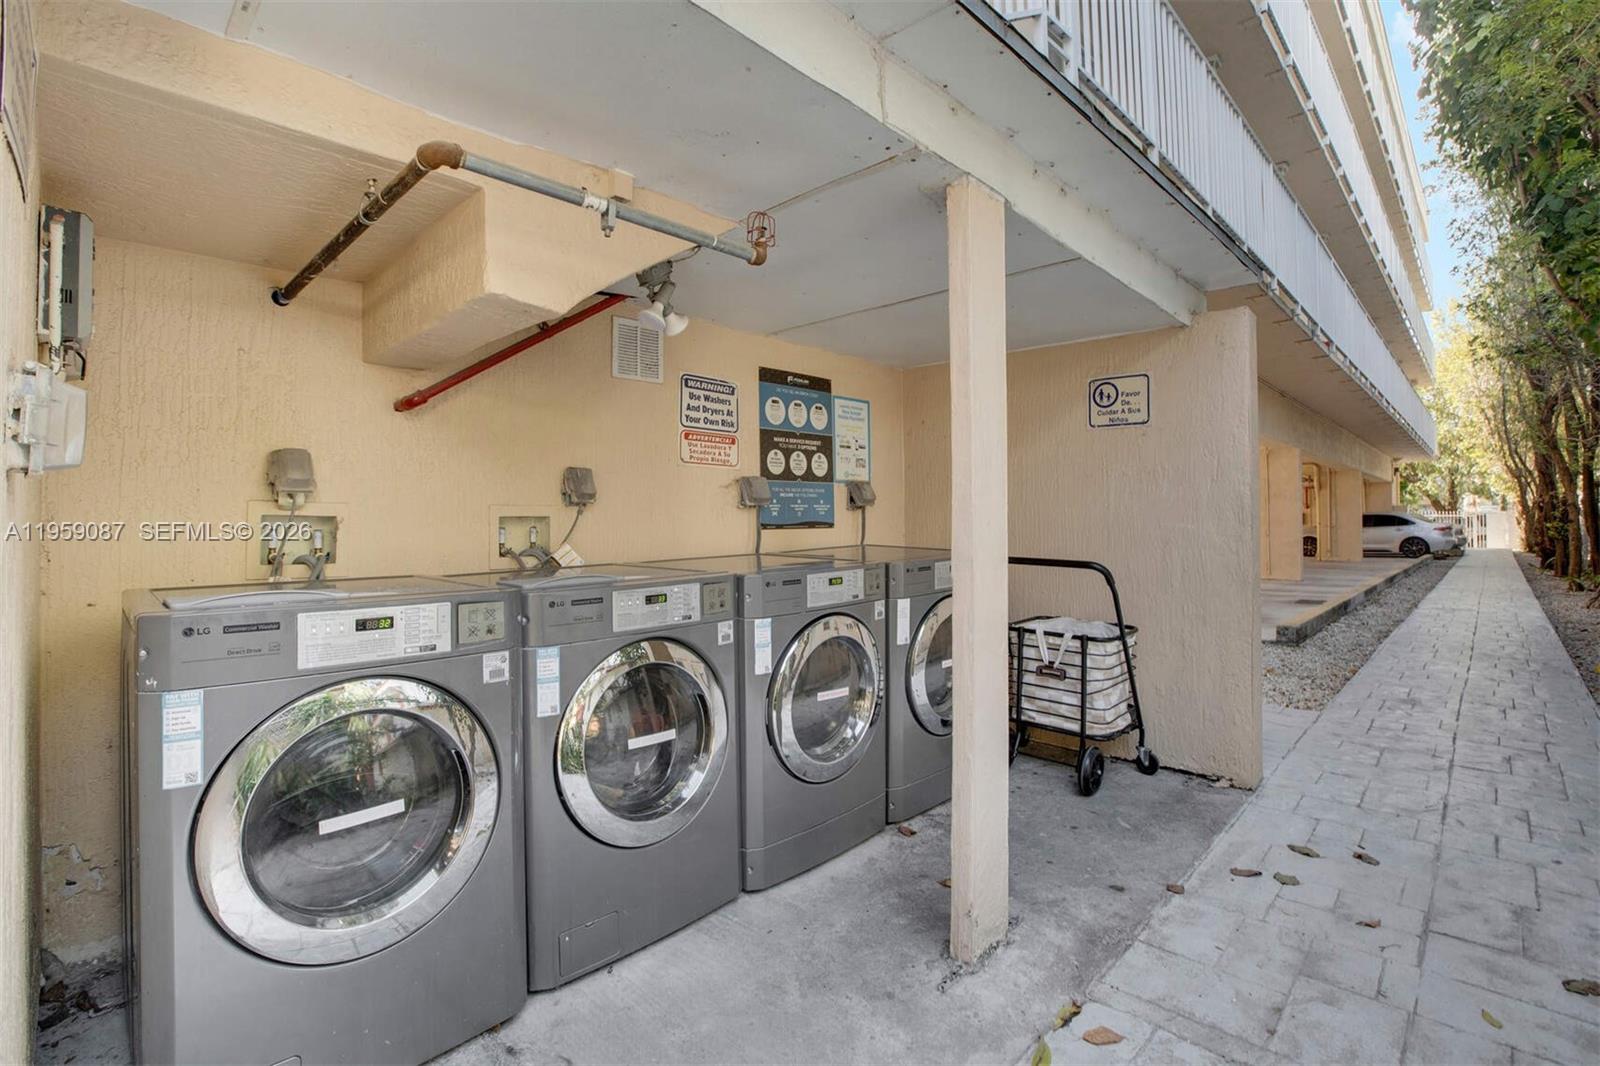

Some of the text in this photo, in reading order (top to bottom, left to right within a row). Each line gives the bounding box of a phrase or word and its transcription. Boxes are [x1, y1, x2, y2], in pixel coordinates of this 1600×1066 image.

[687, 379, 733, 394] WARNING!
[688, 392, 732, 406] Use Washers
[686, 403, 734, 418] And Dryers At
[684, 414, 735, 428] Your Own Risk
[196, 627, 211, 636] LG
